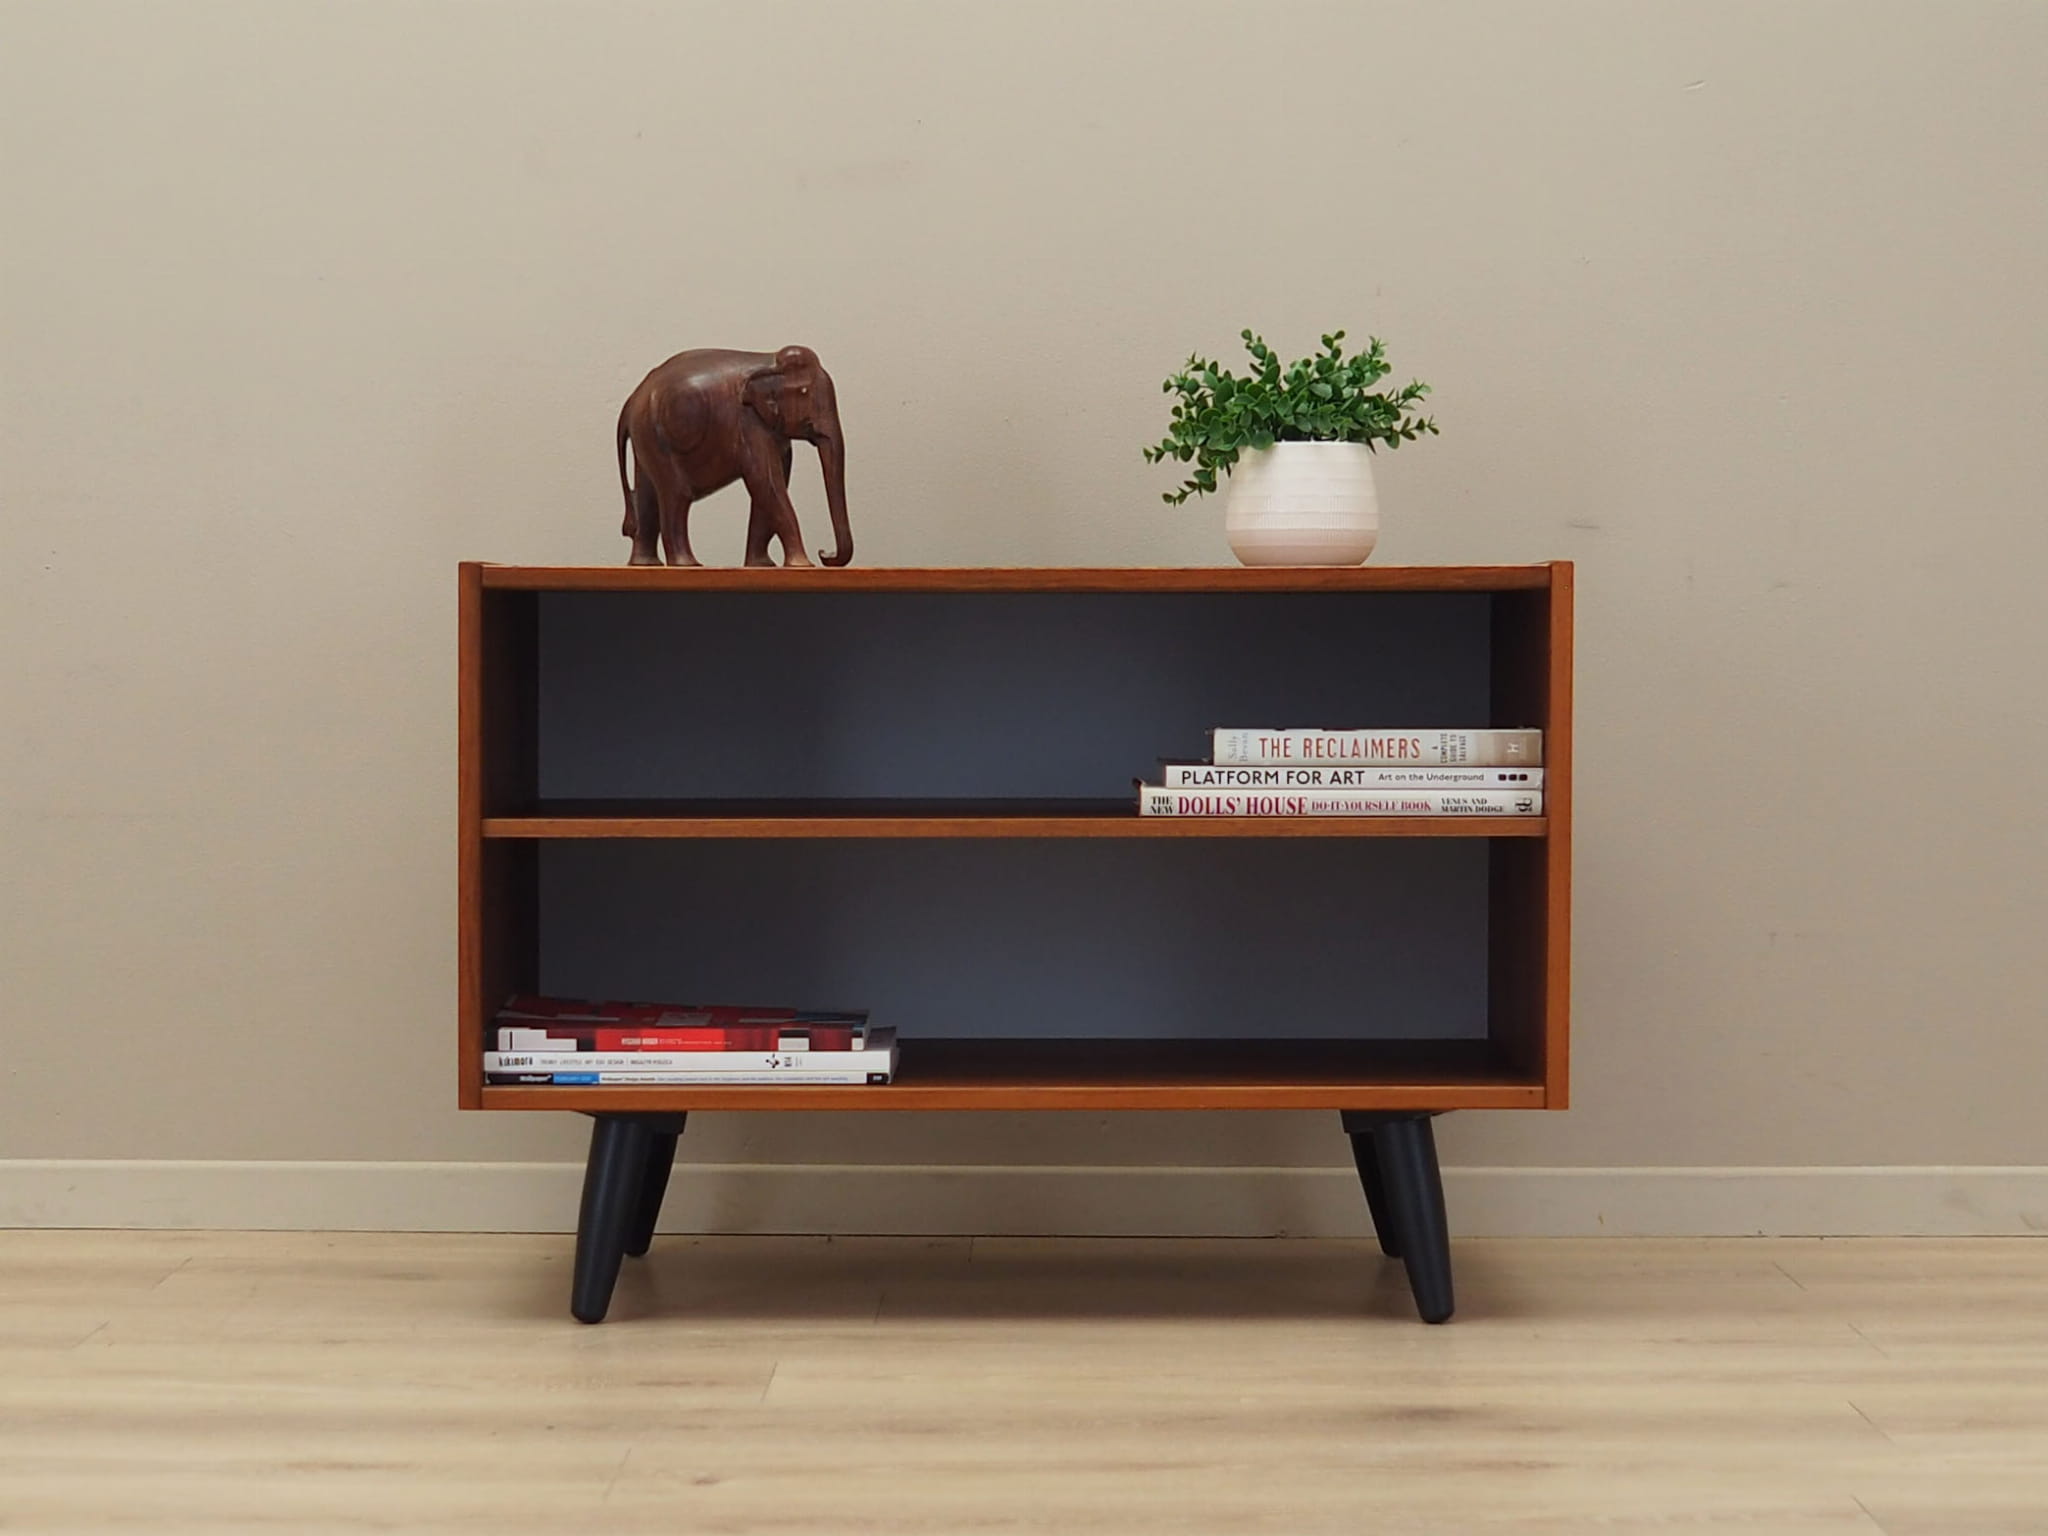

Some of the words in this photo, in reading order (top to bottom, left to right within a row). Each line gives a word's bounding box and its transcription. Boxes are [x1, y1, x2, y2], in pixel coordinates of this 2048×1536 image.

[1258, 737, 1292, 758] THE
[1303, 737, 1421, 759] RECLAIMERS
[1181, 770, 1279, 785] PLATFORM
[1286, 770, 1322, 785] FOR
[1329, 770, 1365, 785] ART
[1378, 773, 1392, 781] Art
[1408, 773, 1424, 781] the
[1426, 773, 1484, 783] Underground
[1151, 796, 1173, 805] THE
[1178, 796, 1241, 815] DOLLS'
[1246, 796, 1308, 815] HOUSE
[1401, 799, 1432, 811] BOOK
[1150, 805, 1174, 814] NEW
[1441, 805, 1474, 813] MARTIN
